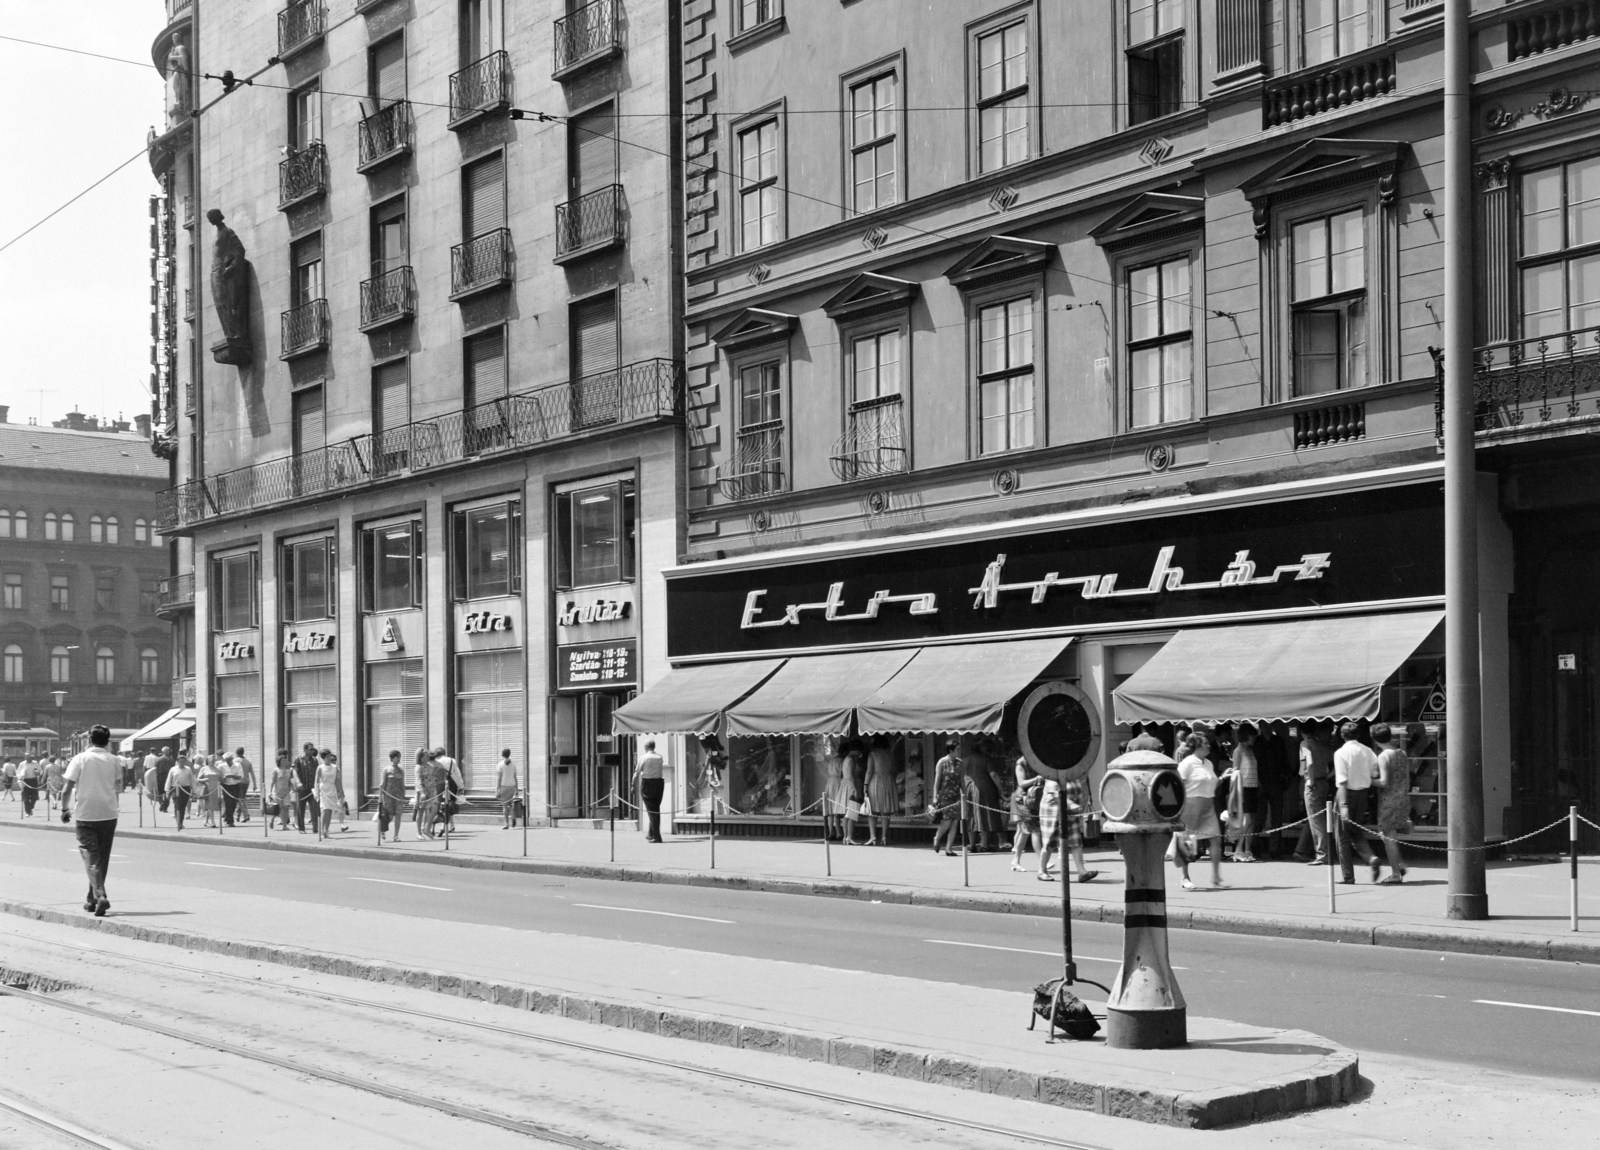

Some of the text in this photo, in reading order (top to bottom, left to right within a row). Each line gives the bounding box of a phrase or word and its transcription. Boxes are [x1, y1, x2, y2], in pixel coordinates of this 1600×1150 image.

[740, 582, 938, 629] Extra
[461, 611, 510, 634] Extra
[1563, 659, 1569, 668] 6
